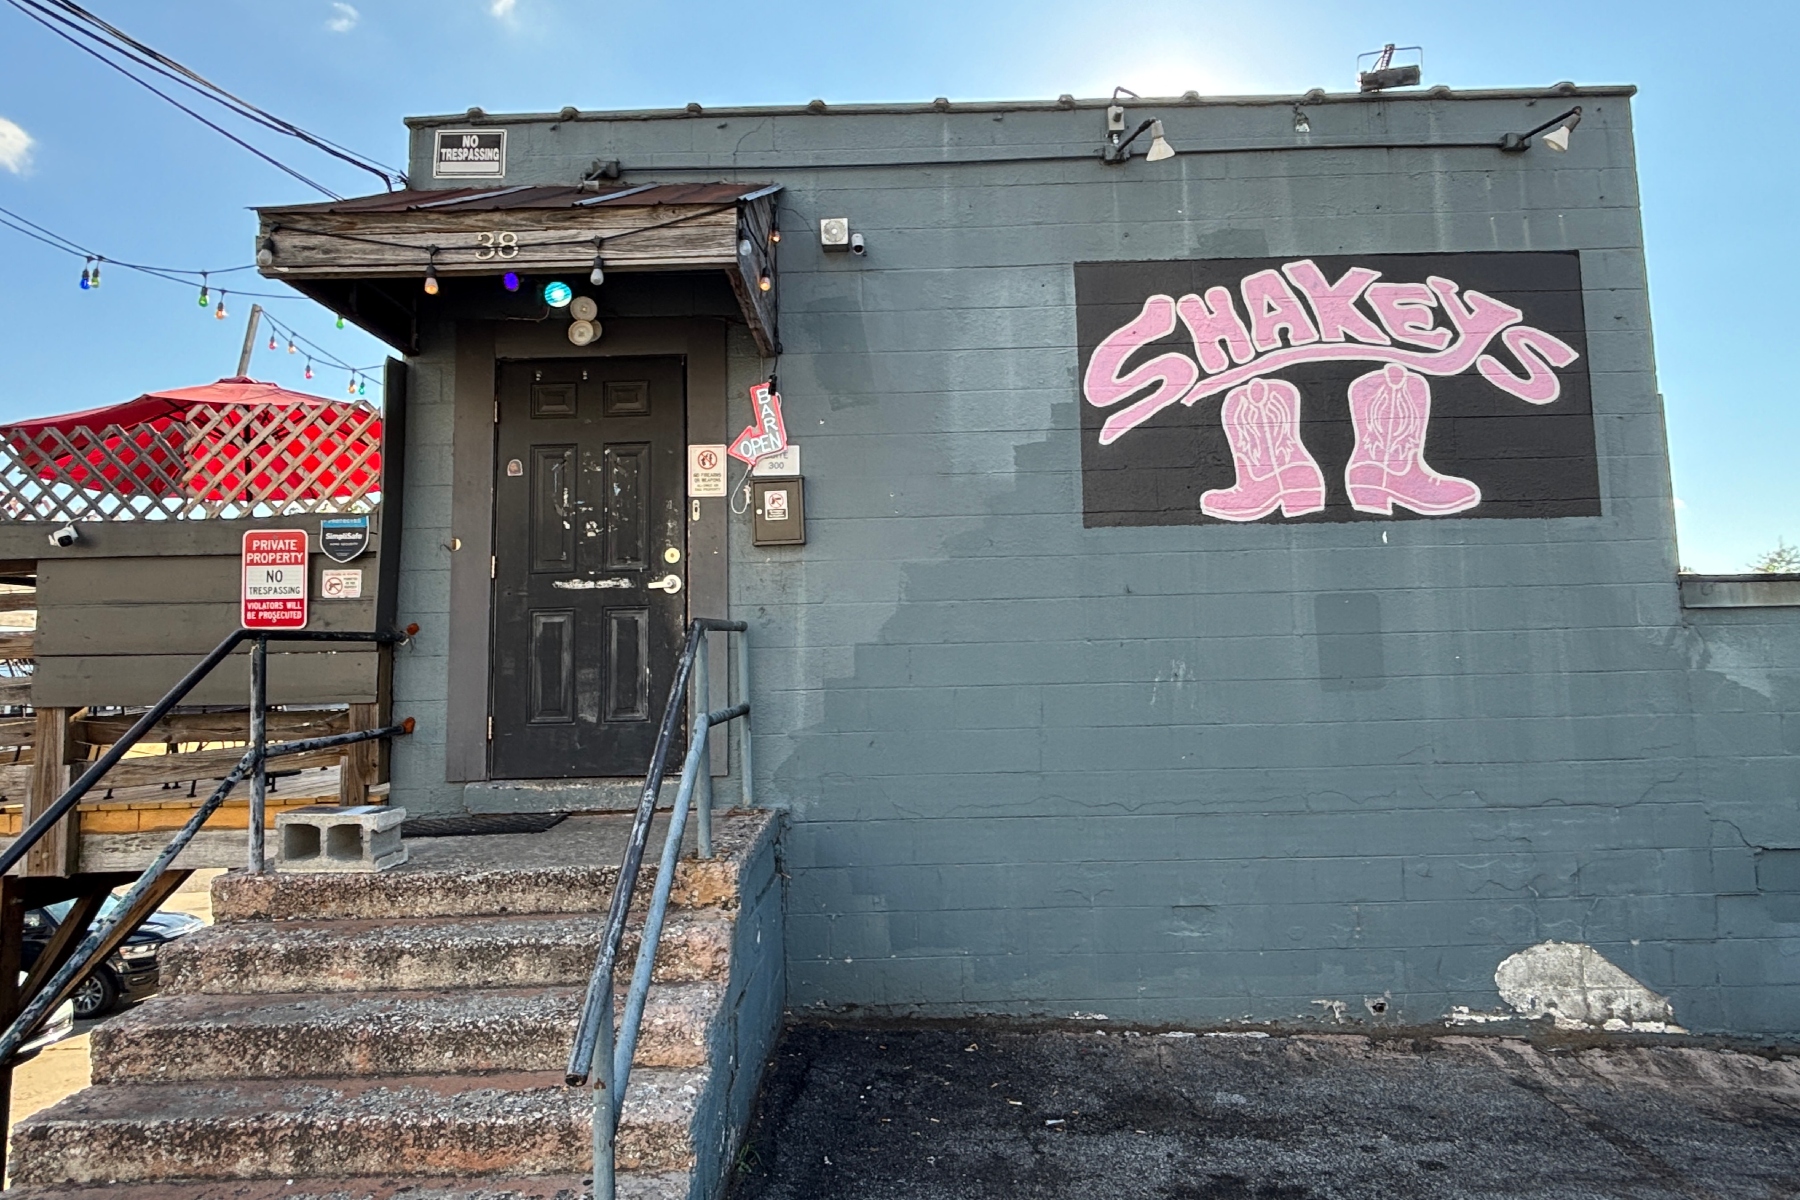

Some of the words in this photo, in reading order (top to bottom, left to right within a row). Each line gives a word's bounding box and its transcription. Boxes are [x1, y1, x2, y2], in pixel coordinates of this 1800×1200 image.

[462, 135, 479, 148] NO
[440, 147, 500, 161] TRESPASSING
[475, 231, 519, 260] 38
[1083, 259, 1579, 445] SHAKEYS
[756, 388, 778, 433] BAR
[740, 432, 782, 458] OPEN
[768, 461, 785, 470] 300
[325, 532, 363, 541] SimpliSafe
[252, 539, 298, 551] PRIVATE
[246, 552, 304, 564] PROPERTY
[266, 569, 283, 583] NO
[249, 586, 301, 596] TRESPASSING
[247, 601, 284, 611] VIOLATORS
[286, 601, 302, 610] WILL
[246, 611, 257, 620] BE
[258, 610, 302, 620] PROSECUTED
